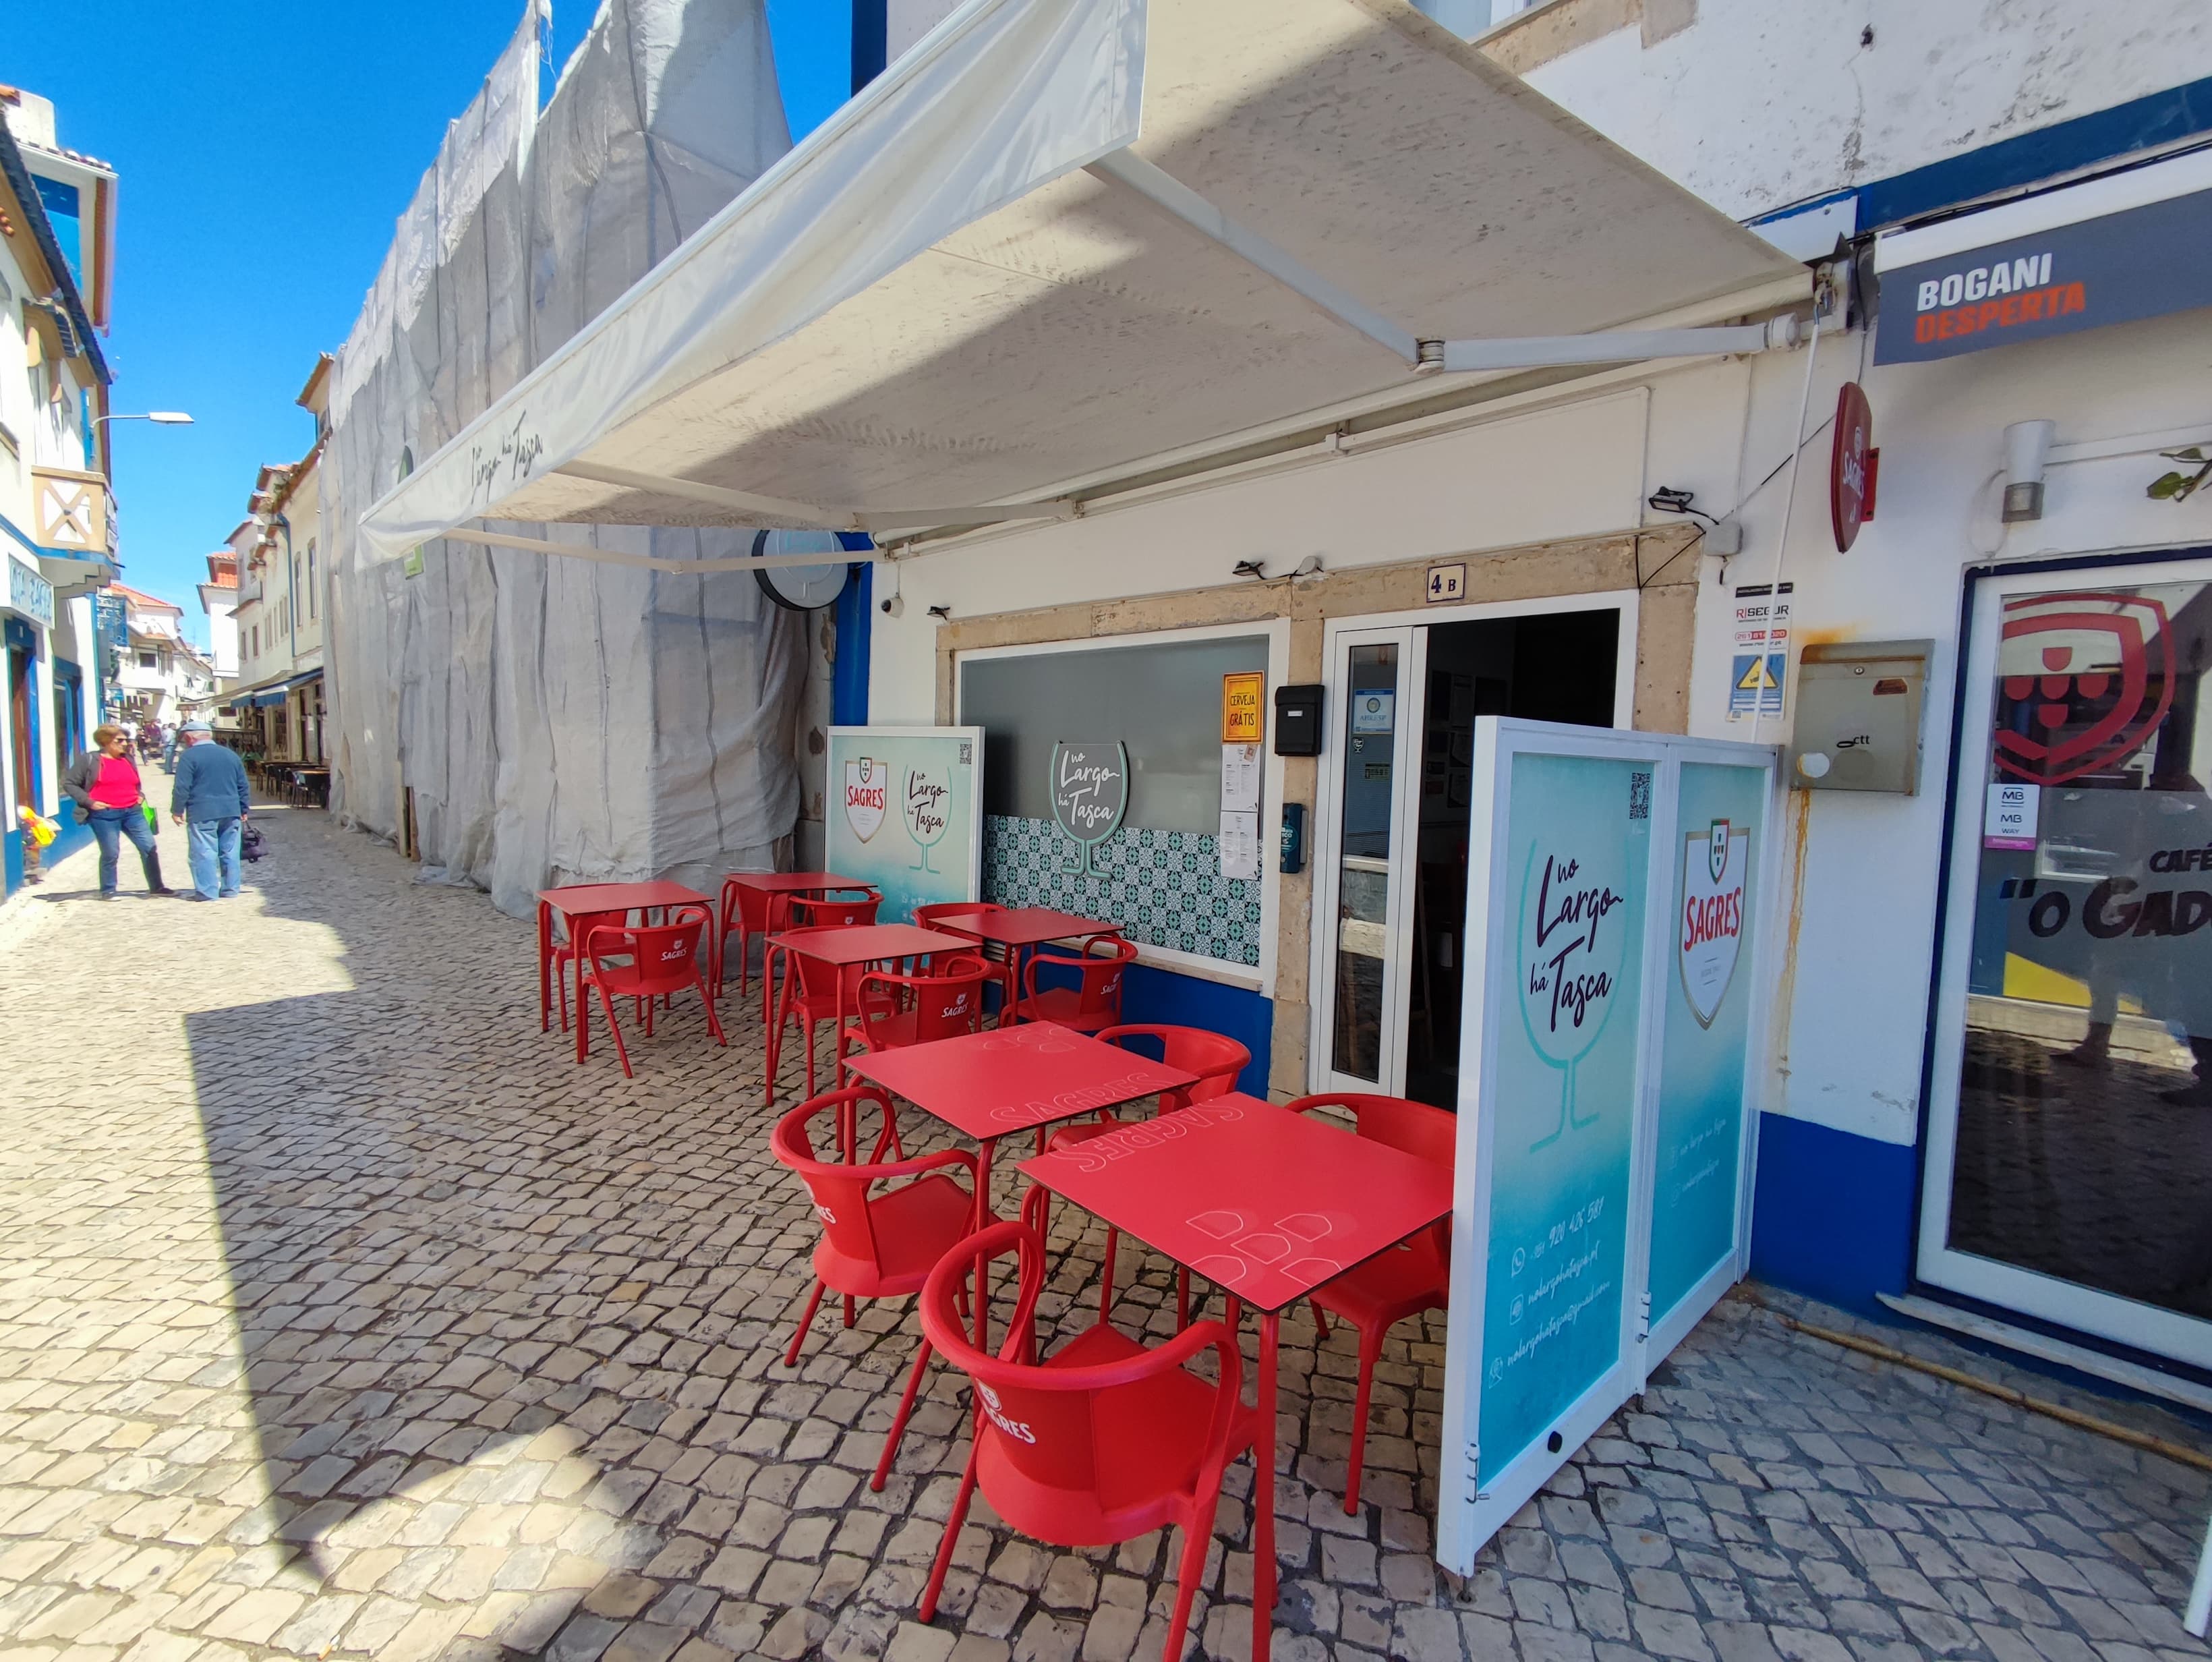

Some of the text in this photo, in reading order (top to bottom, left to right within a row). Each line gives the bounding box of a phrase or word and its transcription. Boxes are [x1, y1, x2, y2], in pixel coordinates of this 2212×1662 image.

[1917, 253, 2053, 311] BOGANI
[1915, 281, 2085, 343] DESPERTA
[513, 409, 543, 481] Tasca
[1431, 574, 1457, 594] 4 B
[1230, 694, 1256, 706] CERVEJA
[1229, 710, 1255, 726] GRÁTIS
[1853, 735, 1870, 745] ctt
[1061, 750, 1120, 797] Largo
[1071, 752, 1086, 764] no
[910, 770, 949, 809] Largo
[917, 772, 926, 781] no
[848, 785, 883, 810] SAGRES
[1058, 793, 1070, 806] há
[1069, 787, 1114, 828] Tasca
[2002, 791, 2024, 801] MB
[914, 801, 945, 834] Tasca
[2000, 814, 2022, 823] MB
[1557, 858, 1579, 884] no
[2149, 842, 2212, 873] CAFÉ
[1537, 855, 1623, 953] Largo
[1684, 886, 1742, 952] SAGRES
[2083, 876, 2212, 939] GAD
[661, 947, 687, 961] SAGRES
[1530, 962, 1548, 995] há
[1548, 936, 1612, 1033] Tasca
[941, 1002, 968, 1018] SAGRES
[990, 1072, 1178, 1130] SAGRES
[1047, 1099, 1244, 1172] SAGRES
[983, 1402, 1037, 1444] GRES
